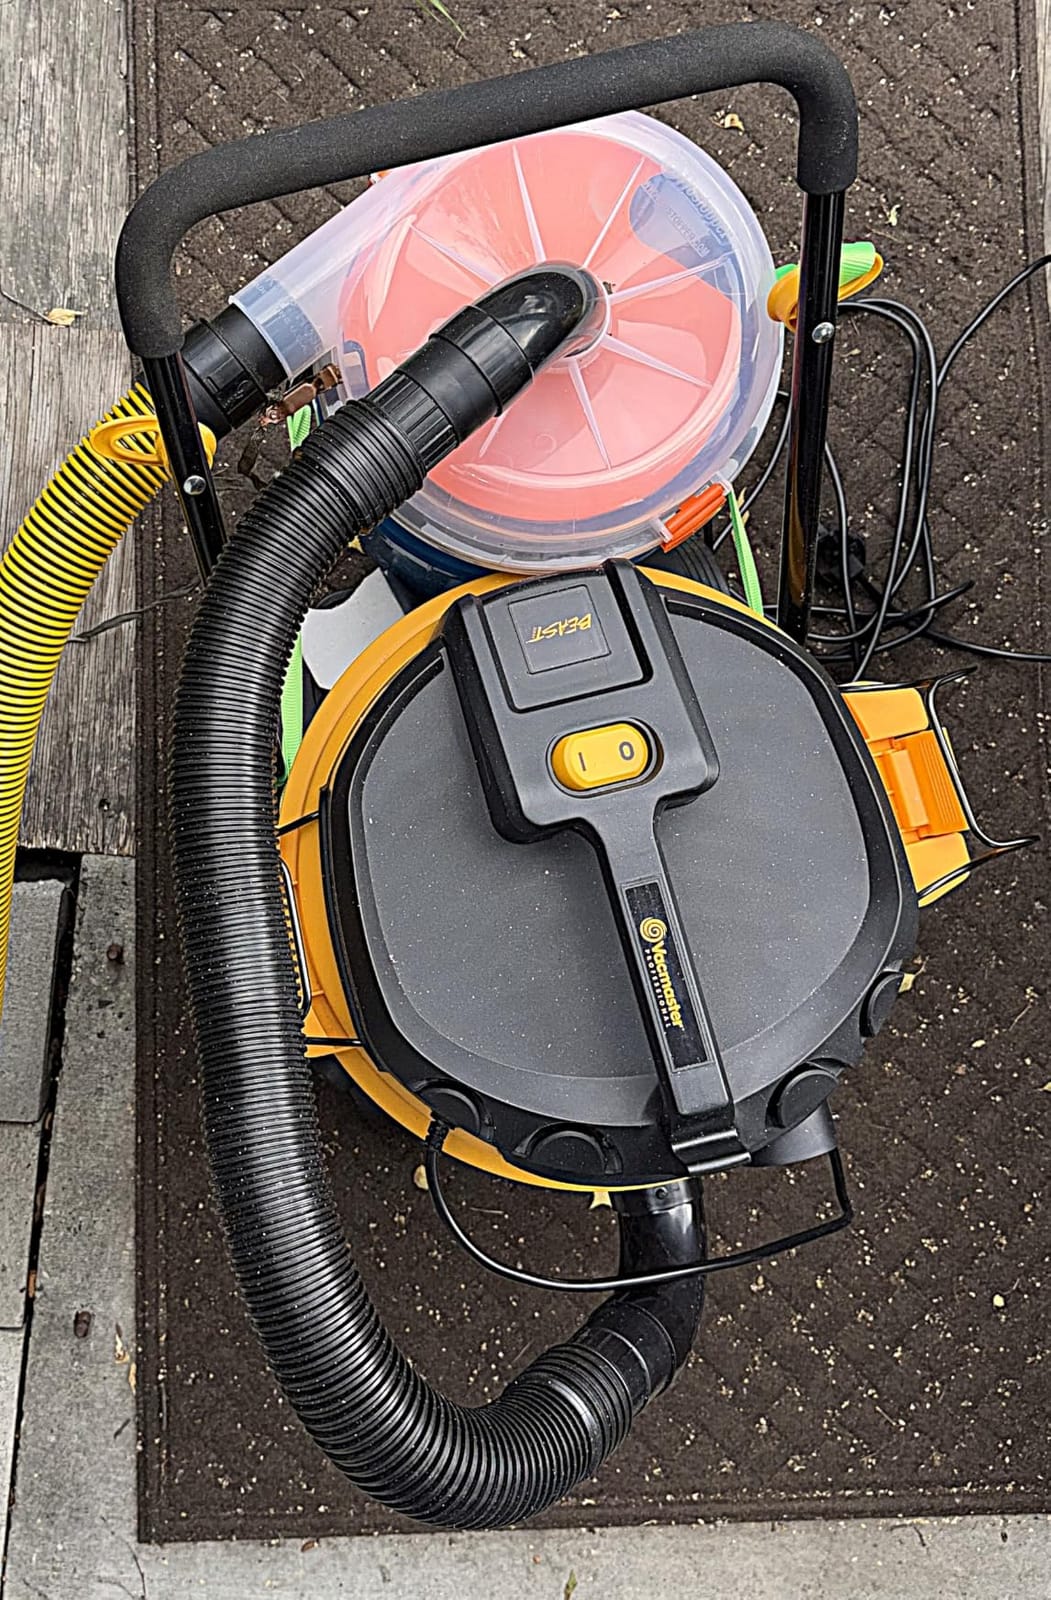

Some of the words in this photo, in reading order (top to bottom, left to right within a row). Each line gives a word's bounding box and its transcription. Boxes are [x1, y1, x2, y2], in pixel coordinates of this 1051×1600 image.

[525, 613, 592, 644] BEAST
[644, 948, 671, 1028] PROFESSIONAL
[652, 940, 684, 1027] Vacmaster
